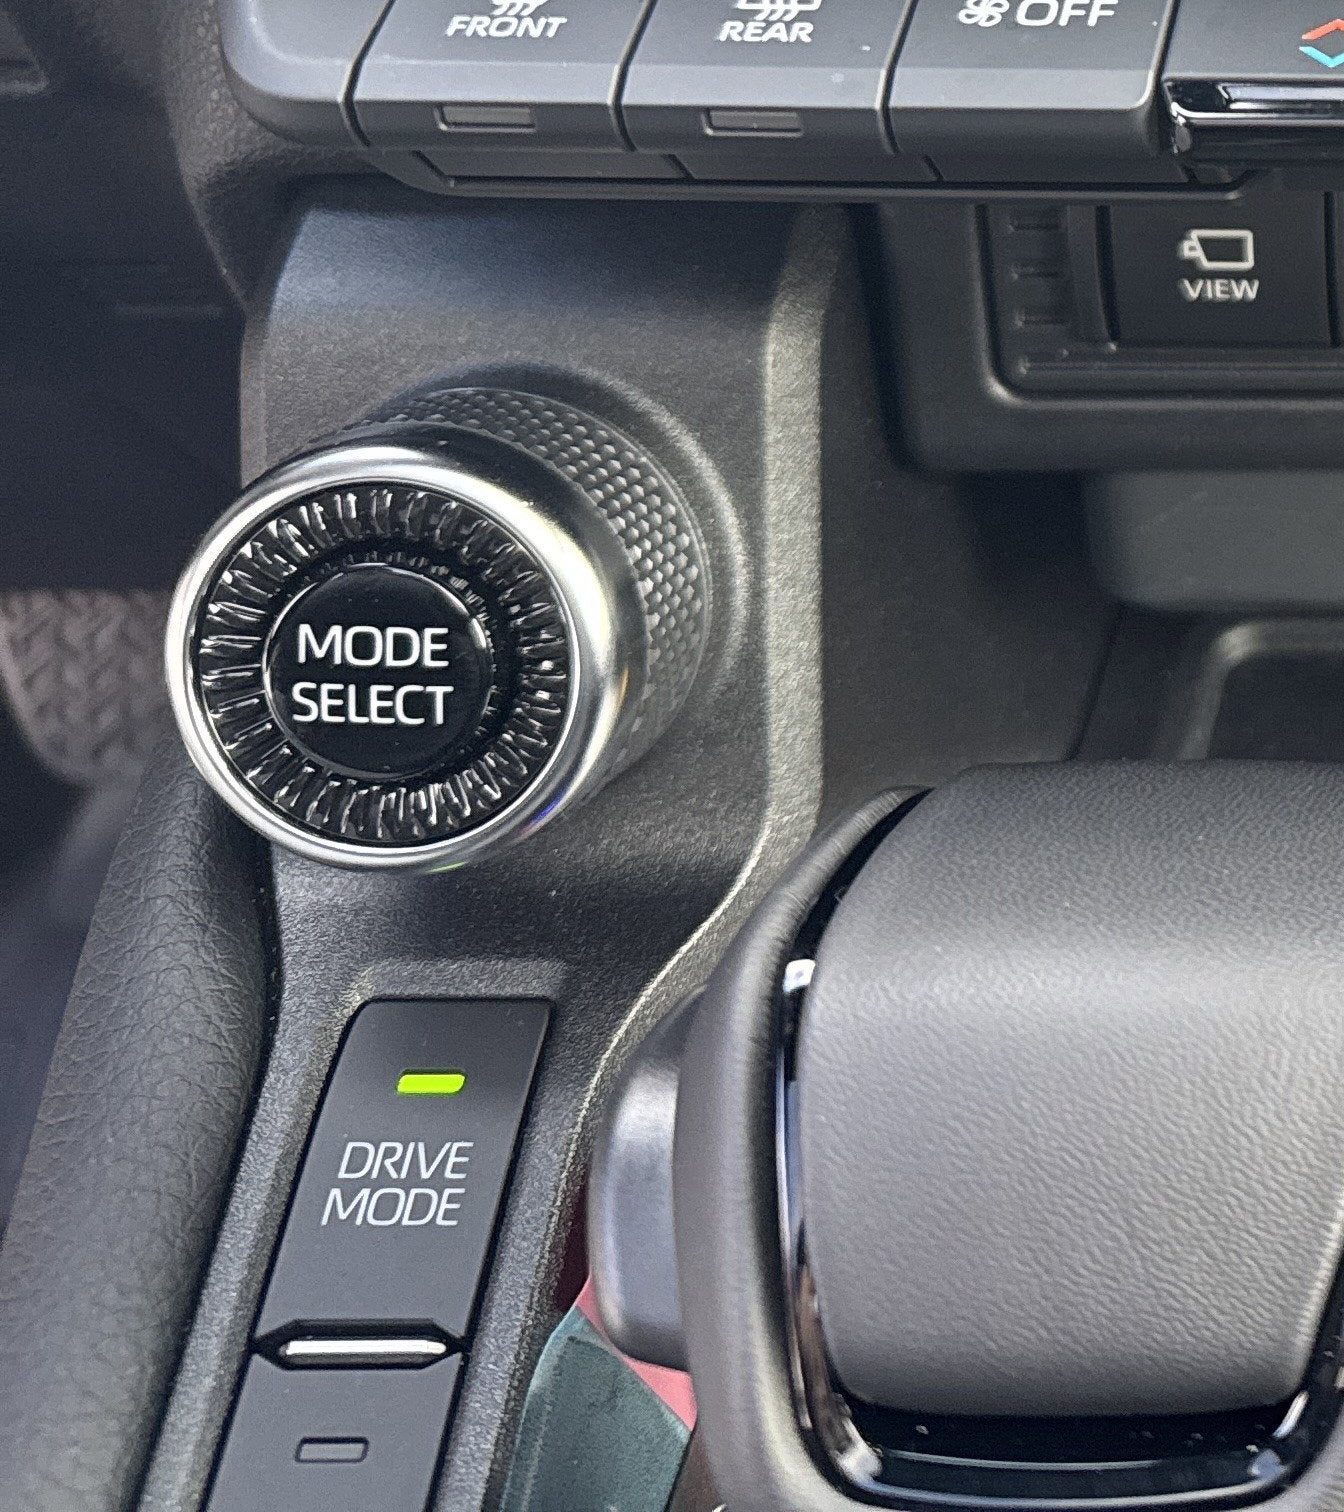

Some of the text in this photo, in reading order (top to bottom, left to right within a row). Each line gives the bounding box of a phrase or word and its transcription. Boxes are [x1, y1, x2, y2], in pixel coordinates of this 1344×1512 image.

[446, 16, 567, 39] FRONT
[718, 22, 814, 44] REAR
[1182, 279, 1259, 301] VIEW
[296, 624, 449, 668] MODE
[291, 682, 454, 726] SELECT
[337, 1141, 474, 1180] DRIVE
[320, 1187, 465, 1227] MODE
